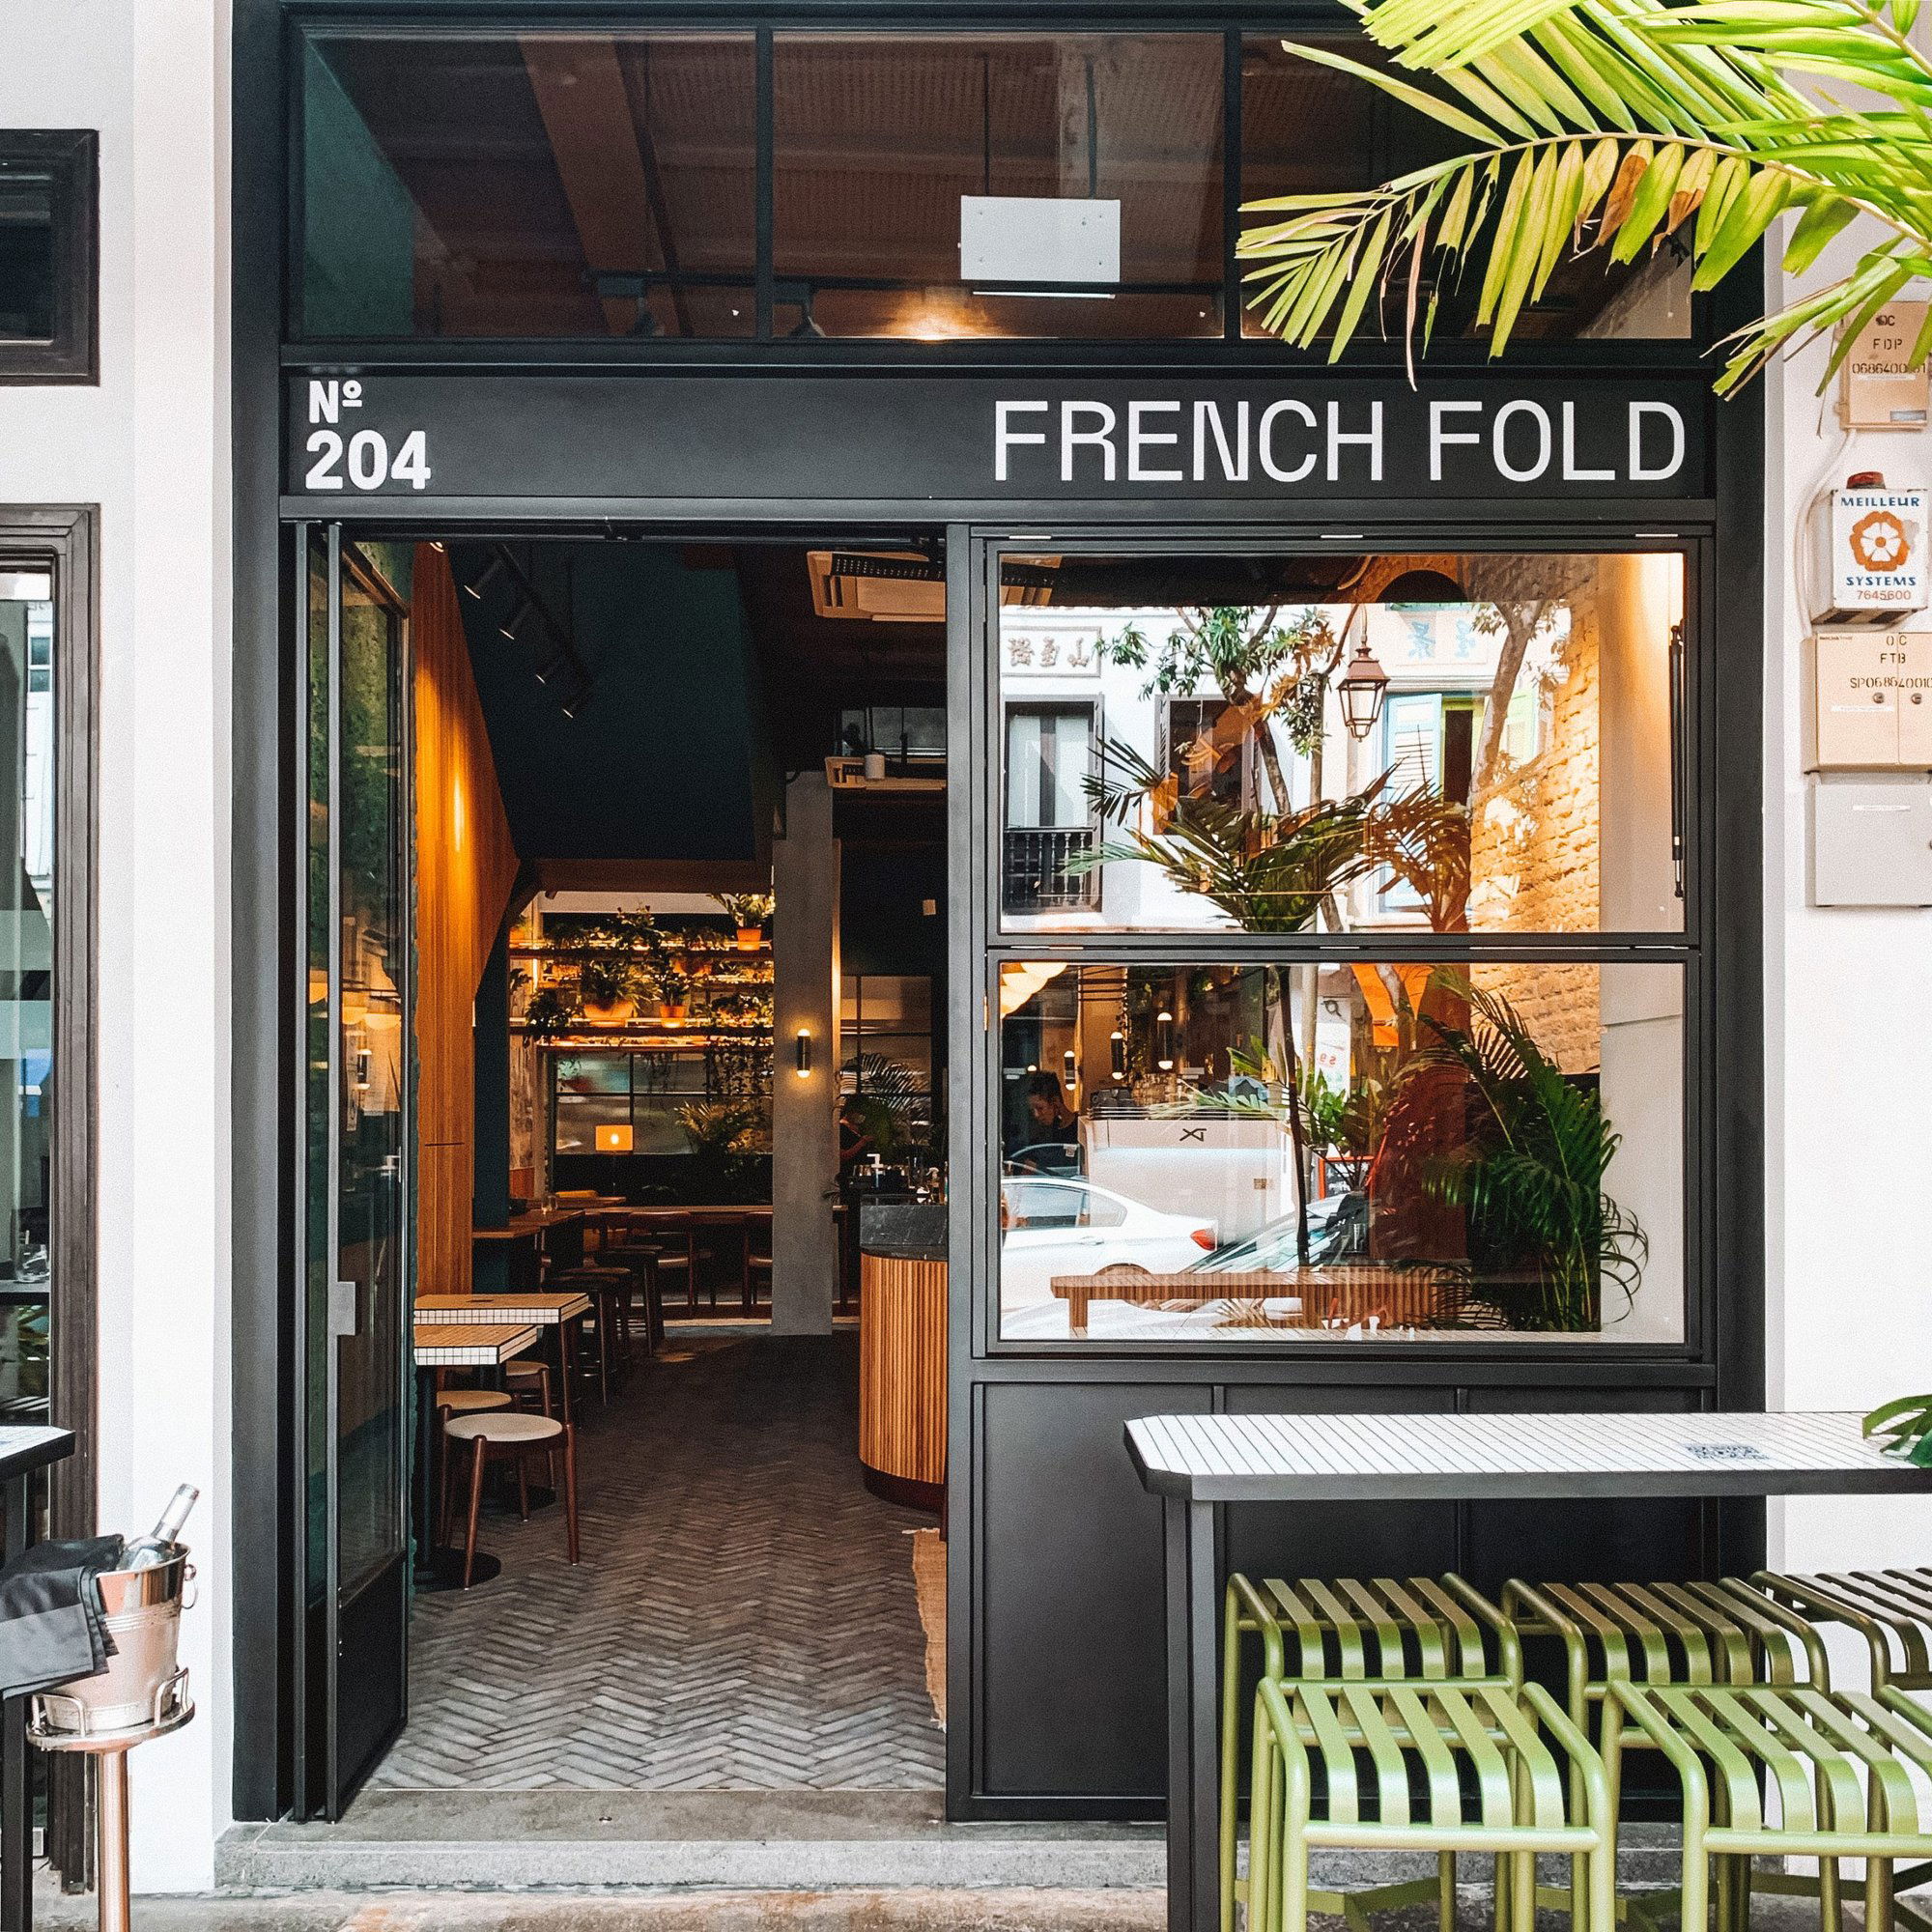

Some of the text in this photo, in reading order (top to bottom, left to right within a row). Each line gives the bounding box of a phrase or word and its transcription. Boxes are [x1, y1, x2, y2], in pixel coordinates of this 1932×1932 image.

[1873, 338, 1903, 350] FDP
[994, 400, 1685, 482] FRENCH FOLD
[305, 430, 432, 490] 204
[1841, 497, 1919, 507] MEILLEUR
[1846, 577, 1917, 586] SYSTEMS
[1857, 590, 1912, 601] 7645600
[1880, 653, 1906, 665] FTB
